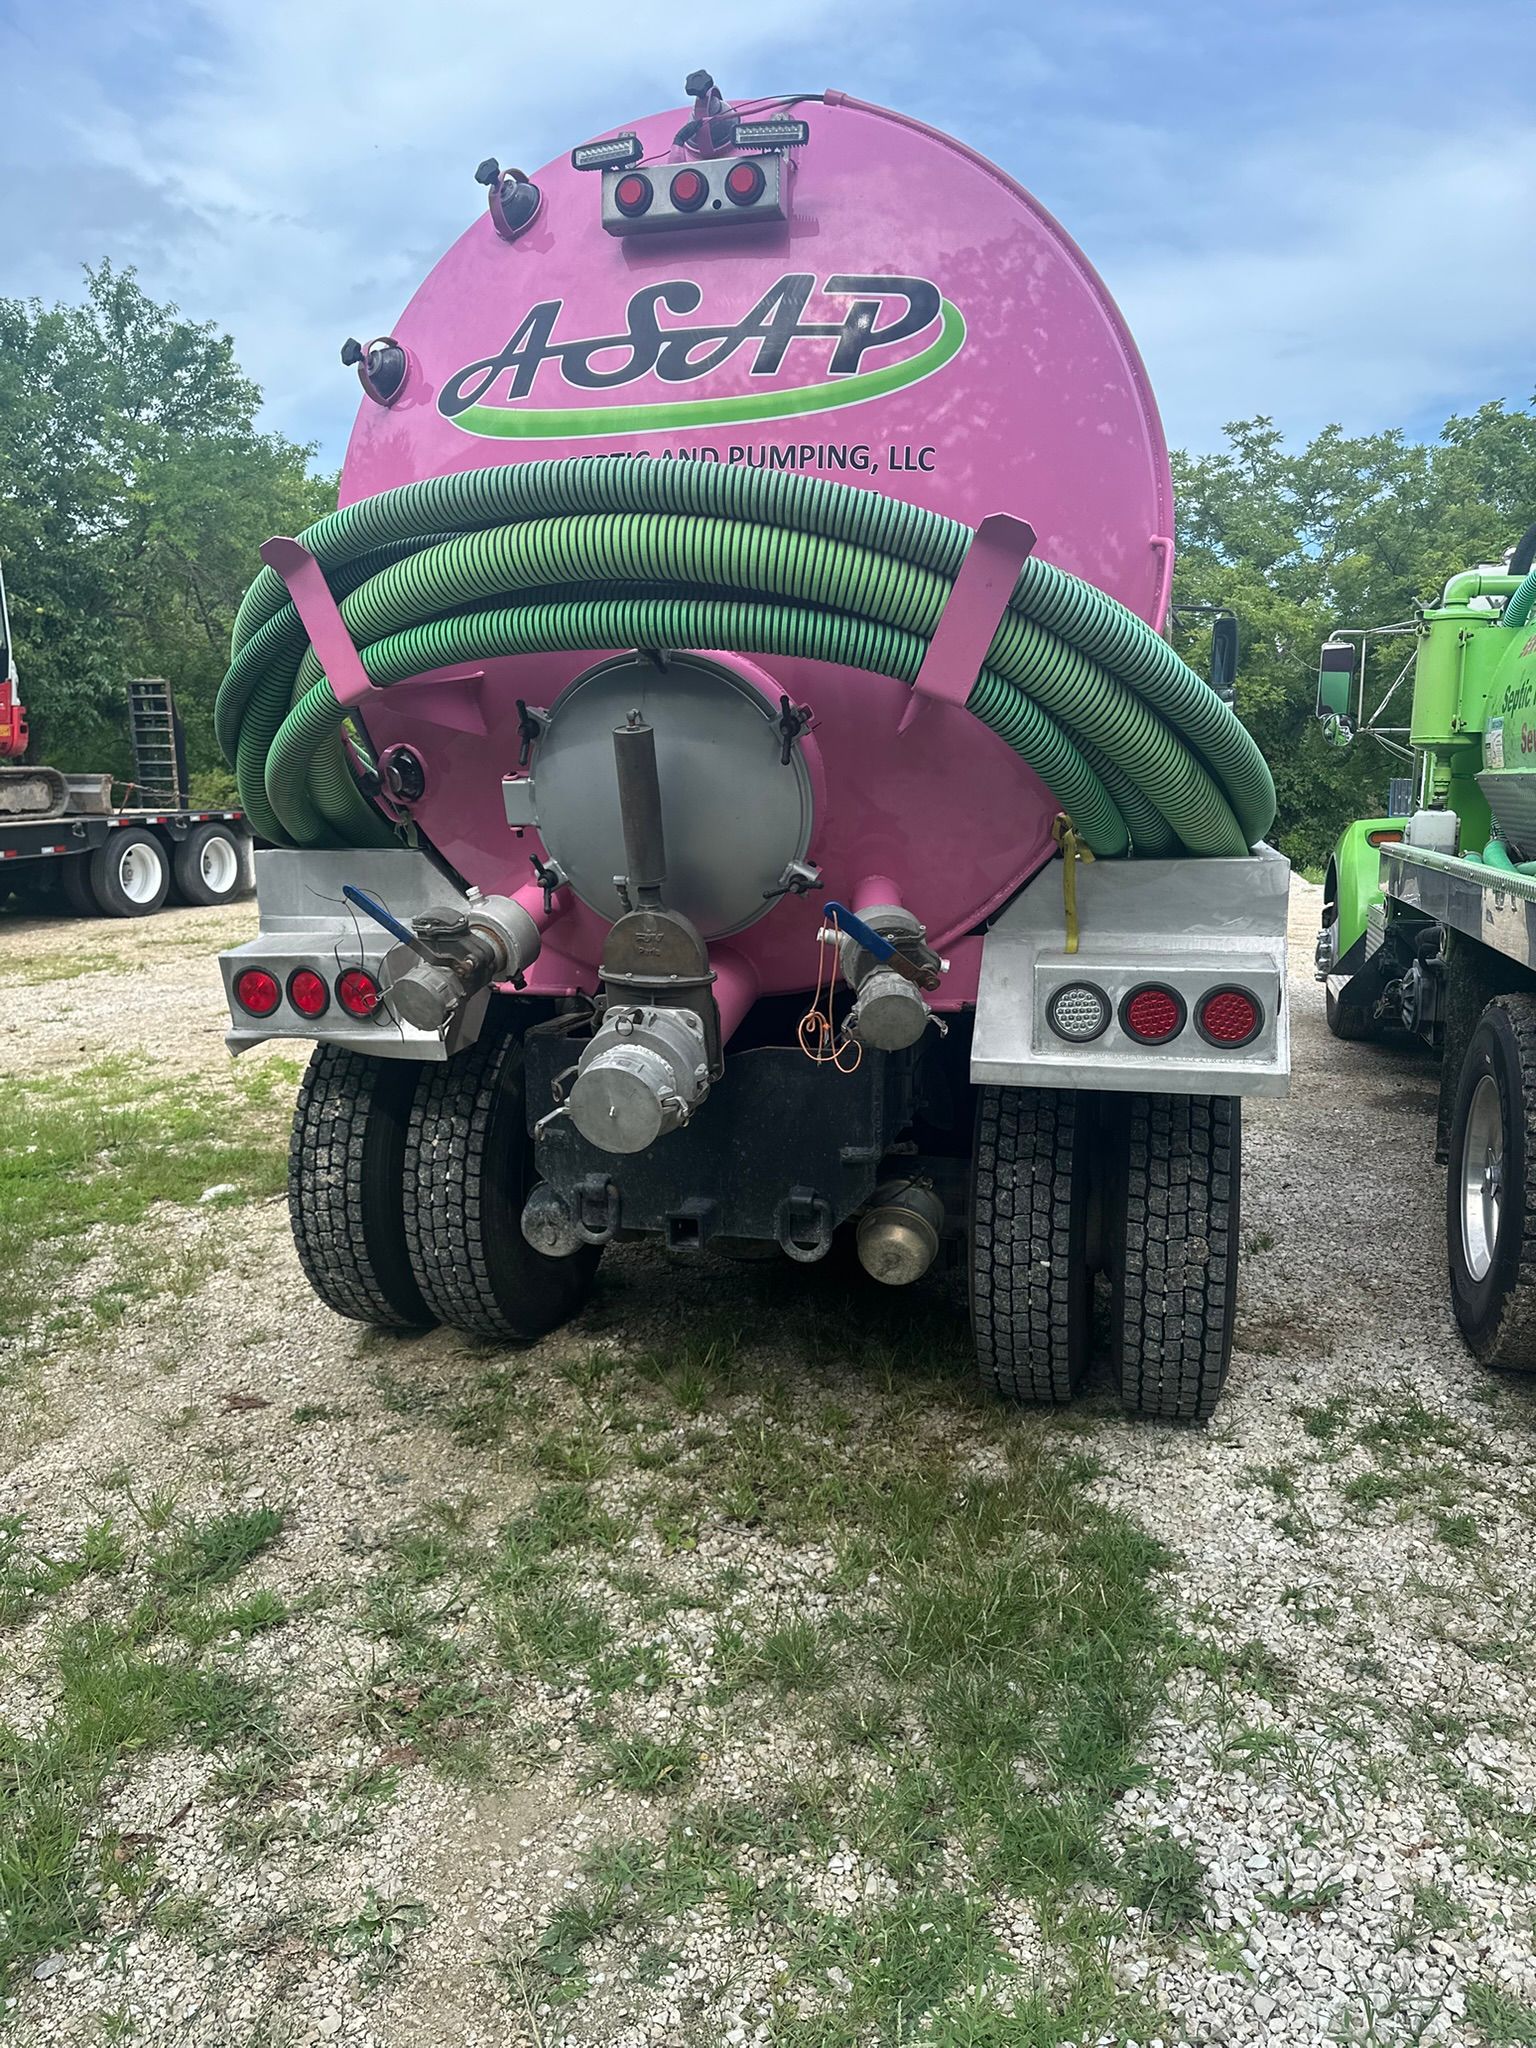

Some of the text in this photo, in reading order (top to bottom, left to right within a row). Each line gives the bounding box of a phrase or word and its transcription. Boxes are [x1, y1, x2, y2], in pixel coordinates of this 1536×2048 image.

[438, 273, 942, 418] ASAP
[729, 445, 879, 474] PUMPING,
[889, 445, 936, 471] LLC
[1502, 679, 1533, 719] Septic
